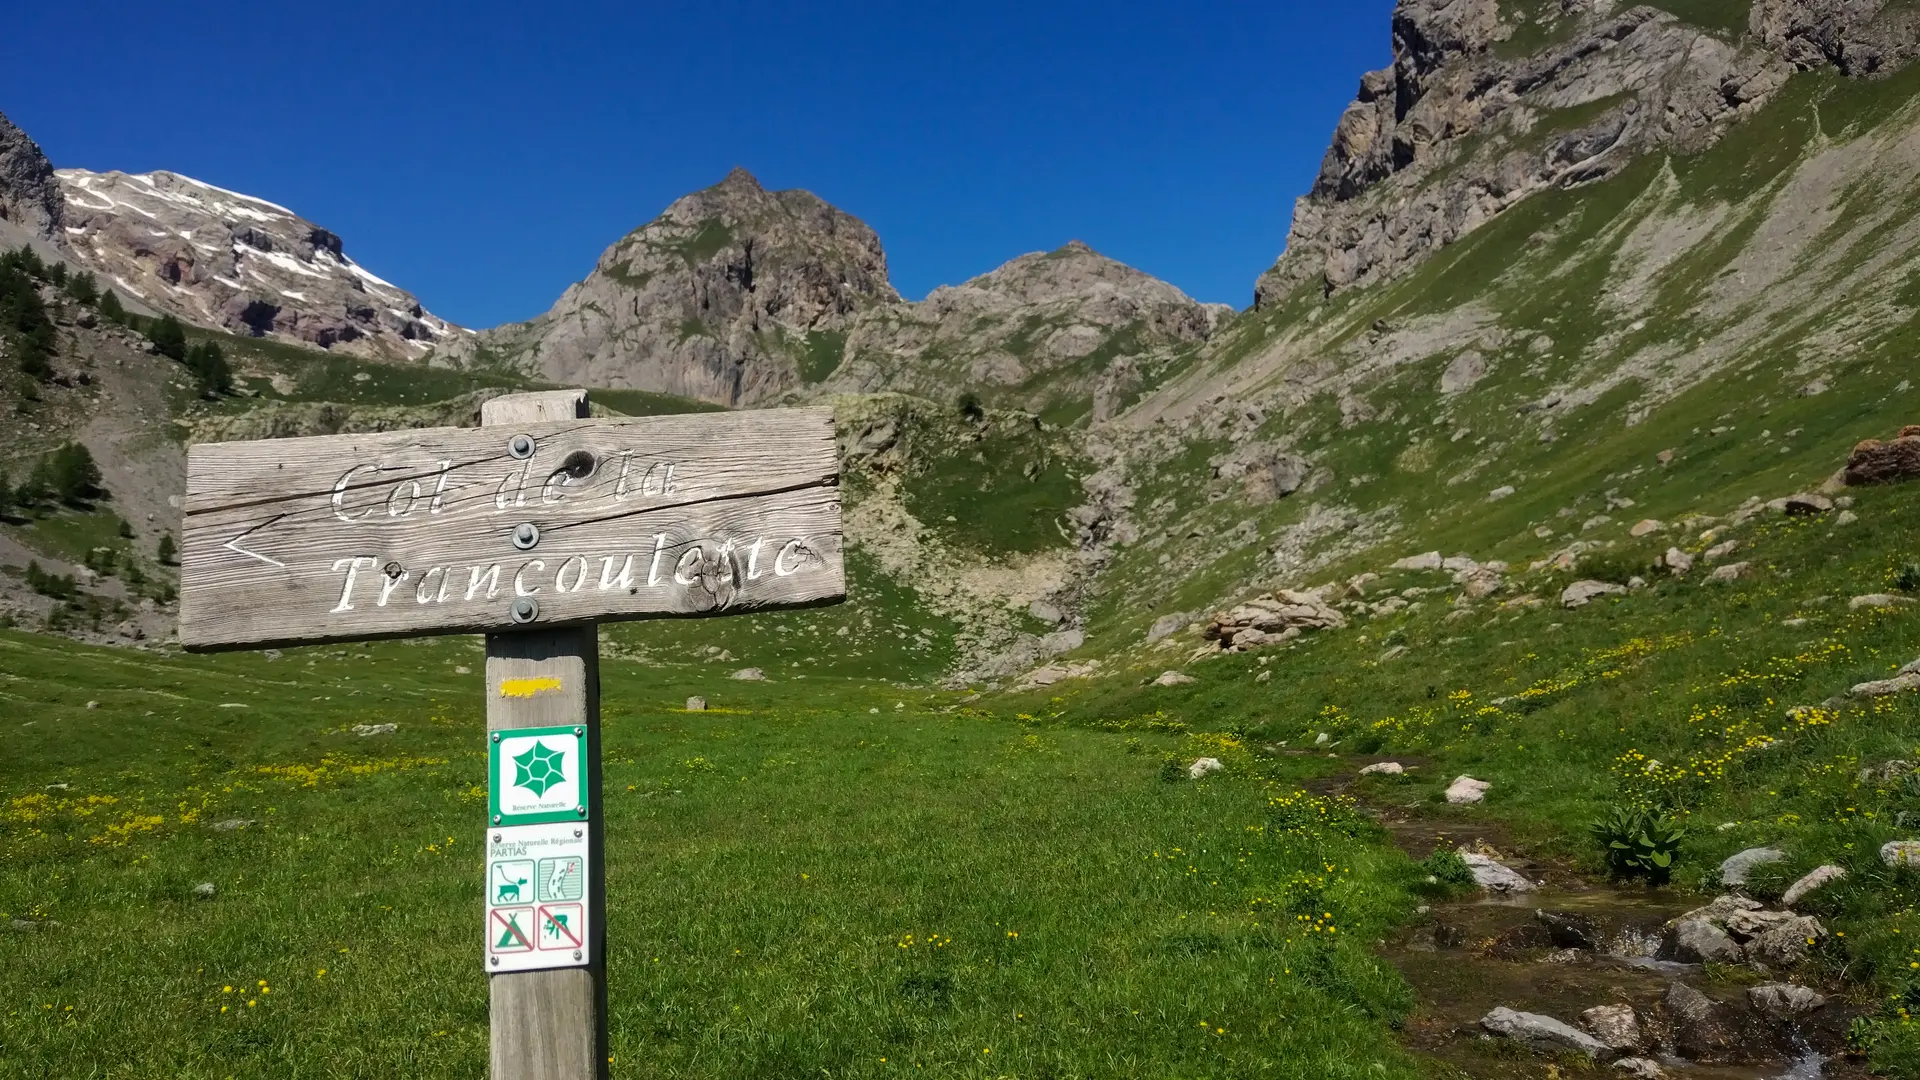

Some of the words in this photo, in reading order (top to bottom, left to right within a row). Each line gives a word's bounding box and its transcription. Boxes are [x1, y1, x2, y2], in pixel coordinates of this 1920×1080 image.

[330, 458, 452, 522] Col
[495, 455, 575, 511] de
[614, 449, 677, 501] la
[329, 532, 804, 614] Trancoulette
[490, 847, 527, 858] PARTIAS
[518, 838, 548, 846] Naturelle
[550, 836, 583, 845] Régionale
